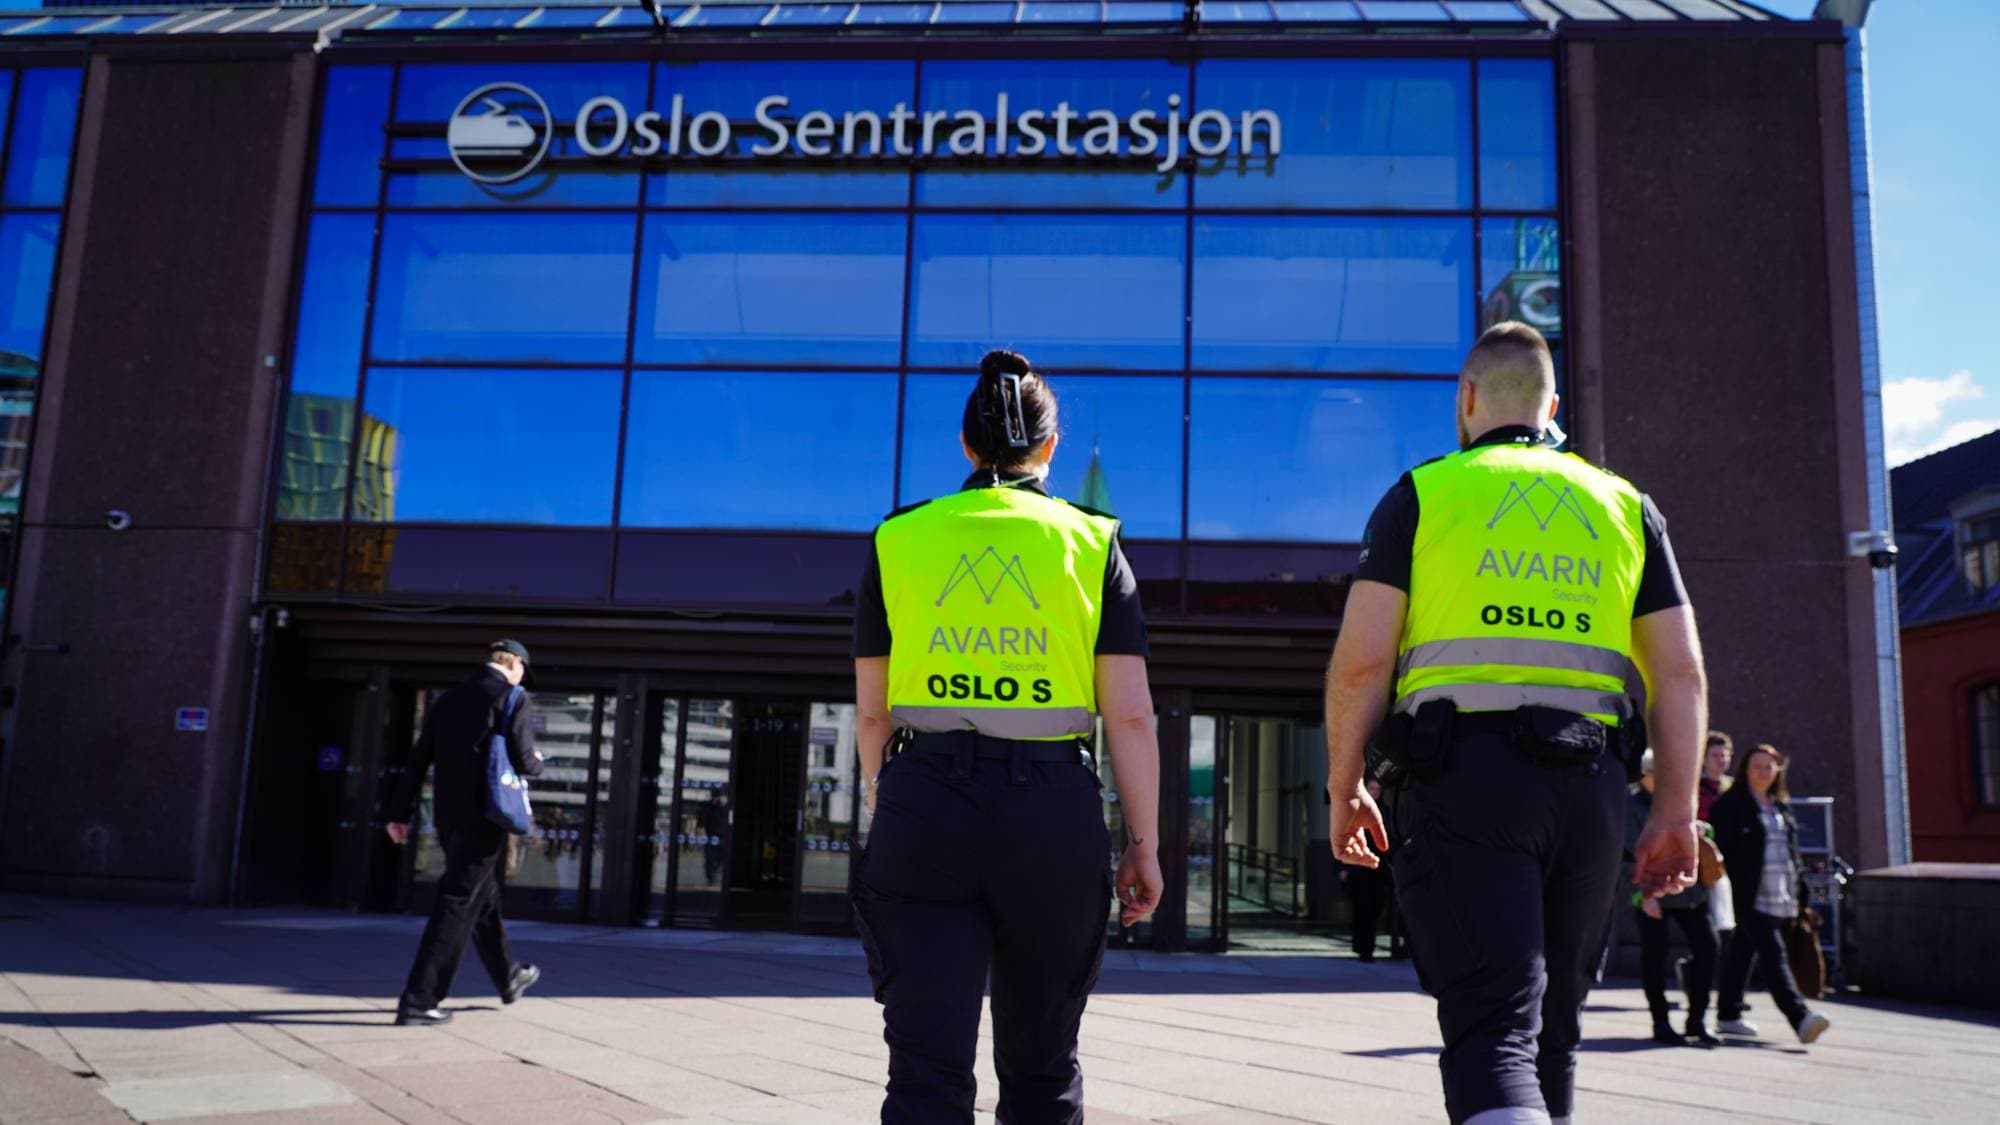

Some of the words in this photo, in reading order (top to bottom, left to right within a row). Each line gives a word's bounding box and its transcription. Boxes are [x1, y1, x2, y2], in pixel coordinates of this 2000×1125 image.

[576, 94, 730, 155] Oslo
[752, 93, 1280, 171] Sentralstasjon
[1476, 548, 1602, 587] AVARN
[1552, 588, 1598, 605] Security
[1481, 604, 1565, 629] OSLO
[1575, 613, 1591, 633] S
[928, 626, 1047, 656] AVARN
[1000, 660, 1047, 672] Security
[927, 674, 1019, 701] OSLO
[1032, 679, 1052, 703] S
